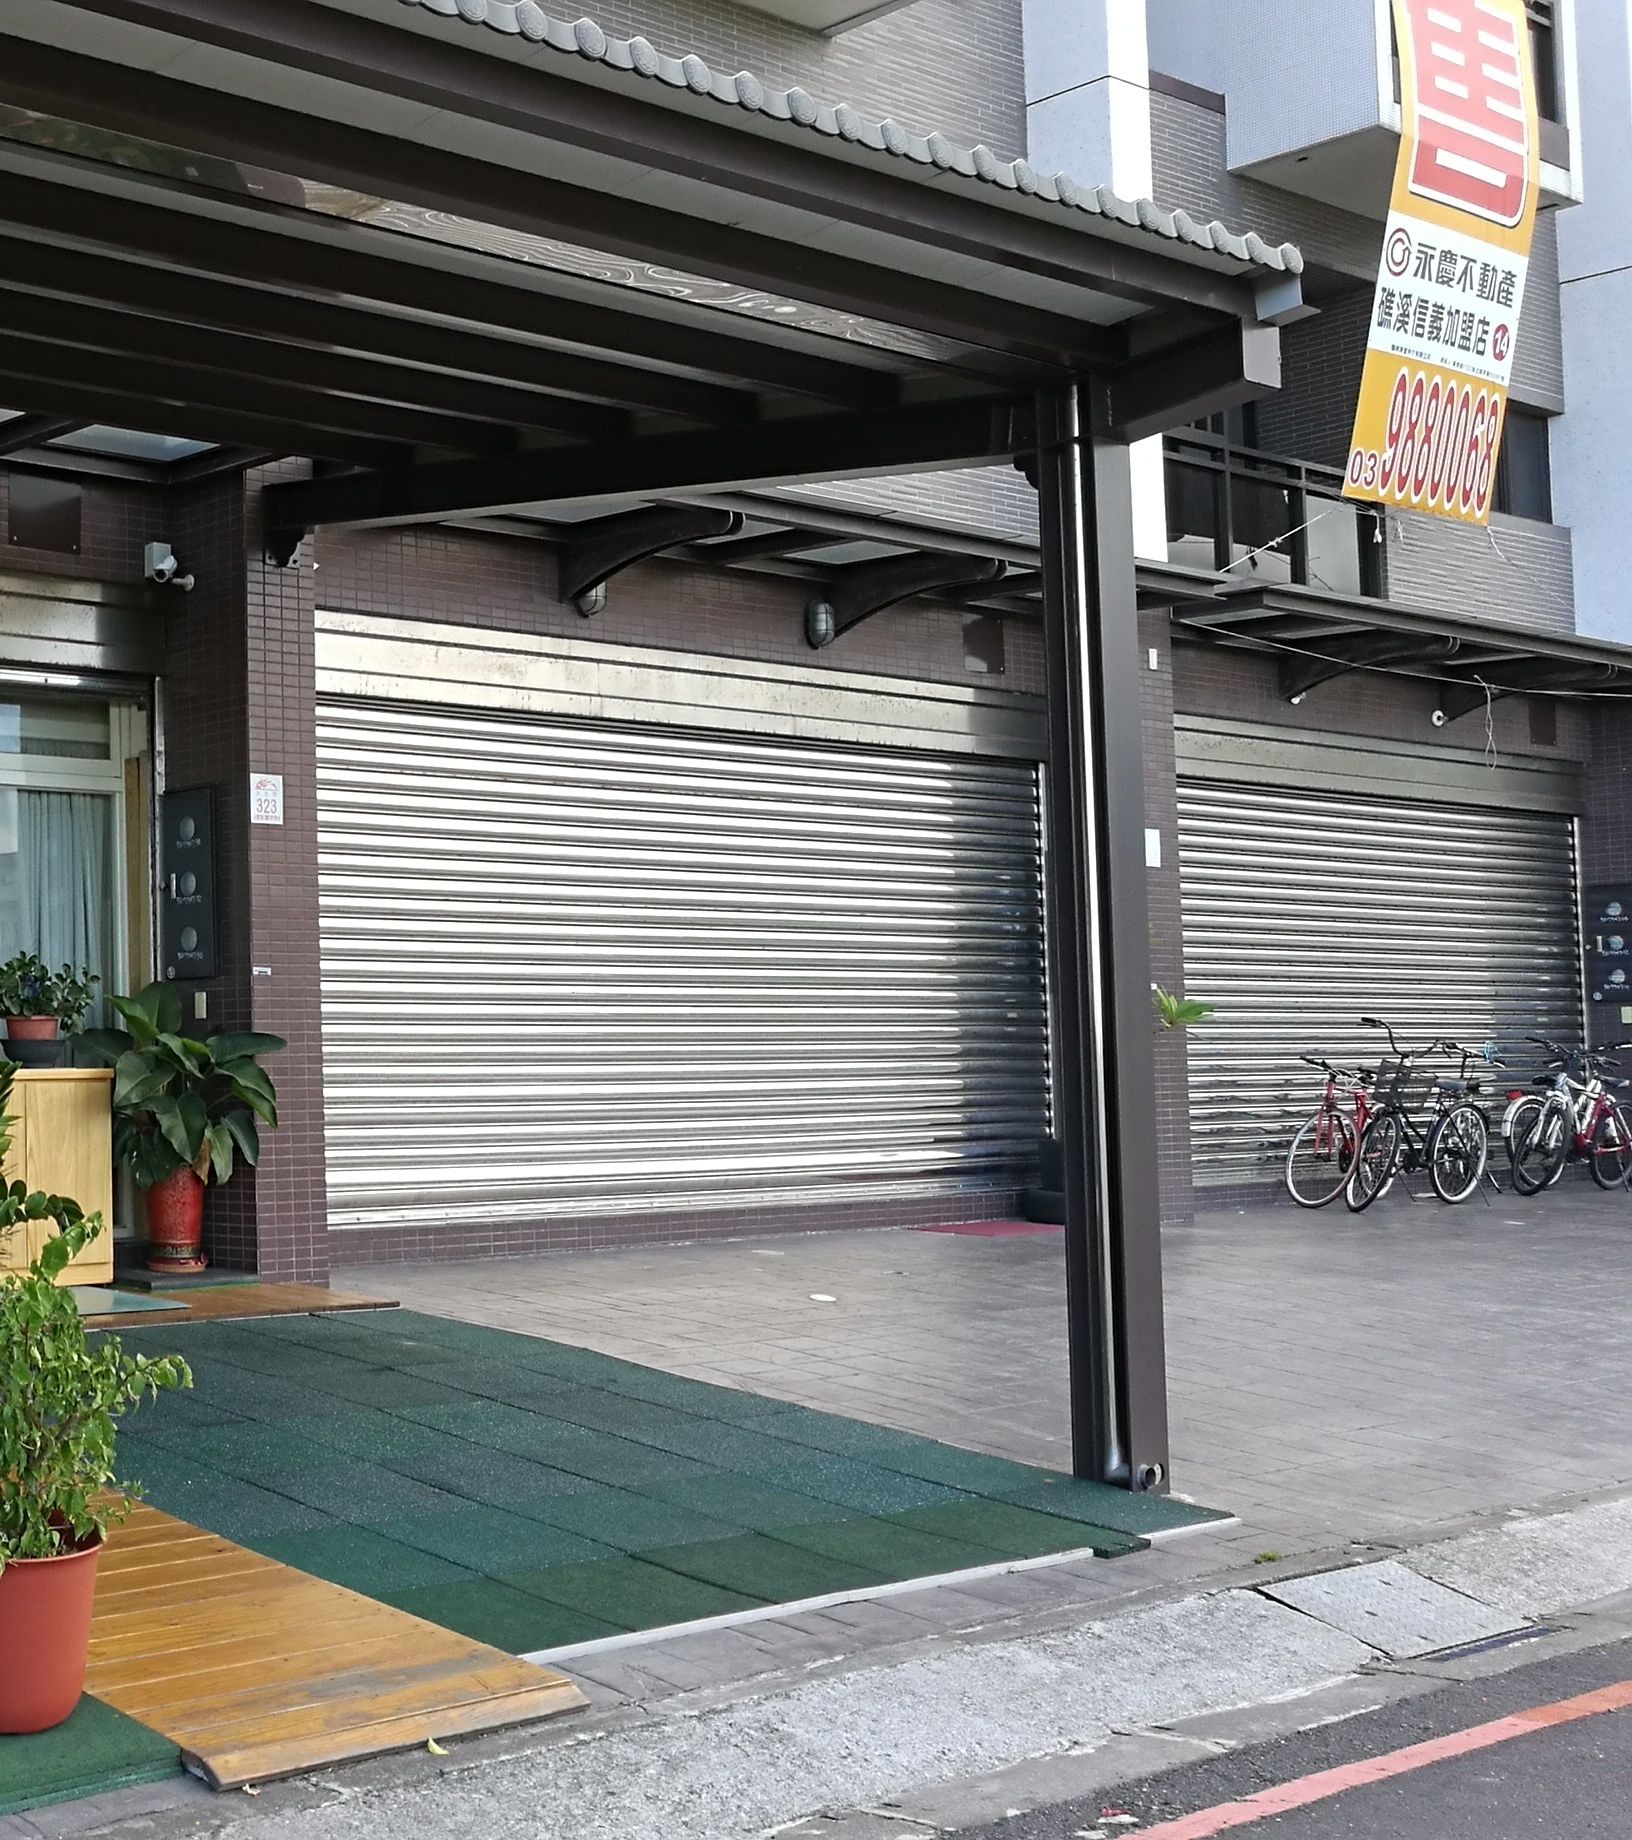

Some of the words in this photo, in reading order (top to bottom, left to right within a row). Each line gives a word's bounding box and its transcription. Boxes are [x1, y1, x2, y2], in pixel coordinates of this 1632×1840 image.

[1413, 242, 1517, 308] 永慶不動產
[1377, 287, 1490, 356] 礁溪信義加盟店
[1494, 326, 1509, 357] 14
[256, 798, 277, 814] 323
